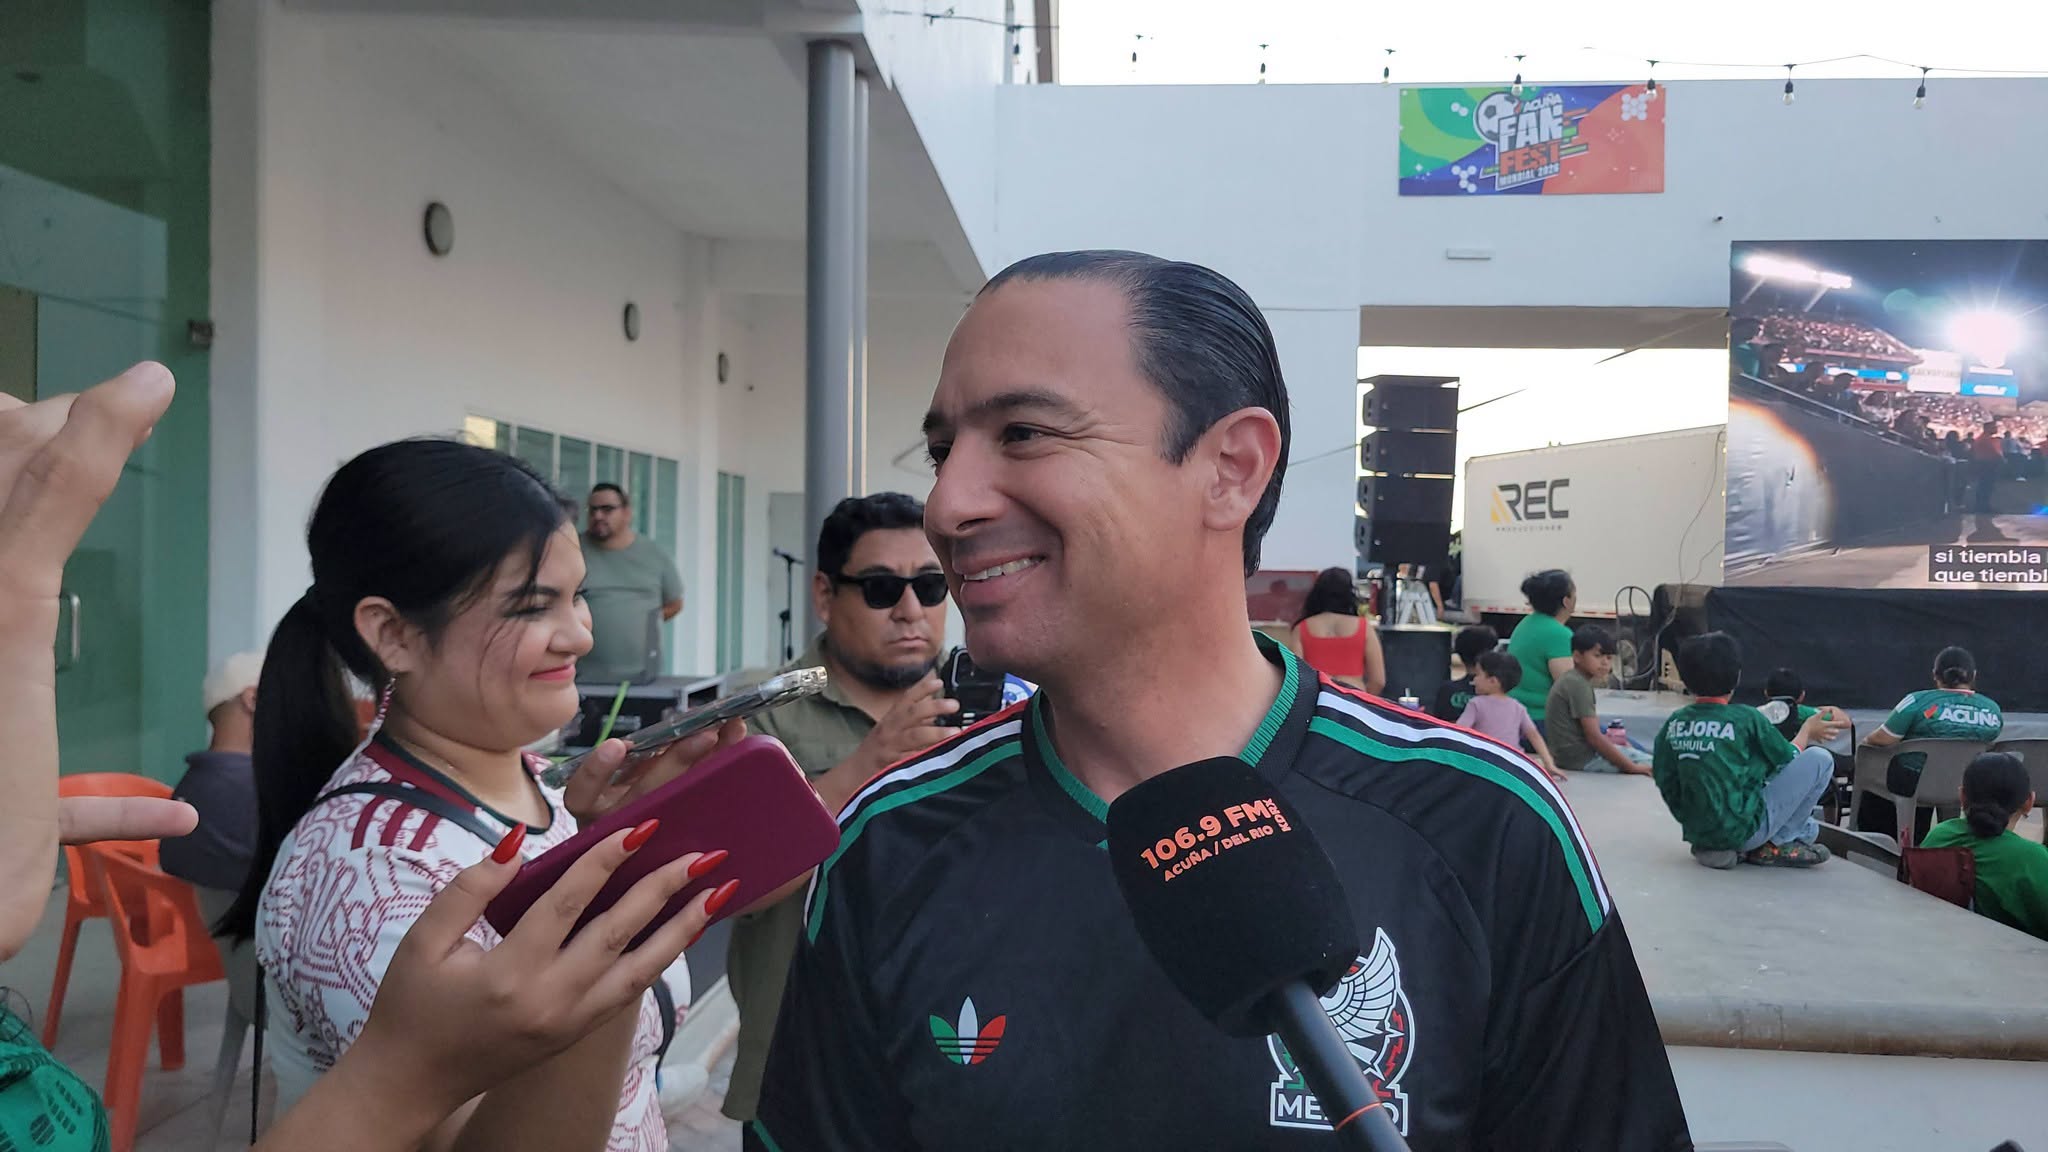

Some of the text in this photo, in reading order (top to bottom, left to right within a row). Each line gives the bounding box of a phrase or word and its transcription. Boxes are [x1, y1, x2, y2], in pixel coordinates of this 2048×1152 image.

[1522, 92, 1563, 112] ACUÑA
[1499, 104, 1563, 153] FAN
[1499, 142, 1560, 177] FEST
[1499, 162, 1560, 186] MUNDIAL 2026
[1497, 477, 1570, 521] REC
[1934, 549, 1954, 564] si
[1959, 549, 2042, 565] tiembla
[1934, 570, 1975, 584] que
[1938, 707, 2002, 728] ACUÑA
[1263, 798, 1292, 833] KDRX
[1140, 799, 1272, 870] 106.9 FM
[1164, 848, 1213, 882] ACUÑA
[1220, 832, 1250, 850] DEL
[1248, 824, 1275, 840] RIO
